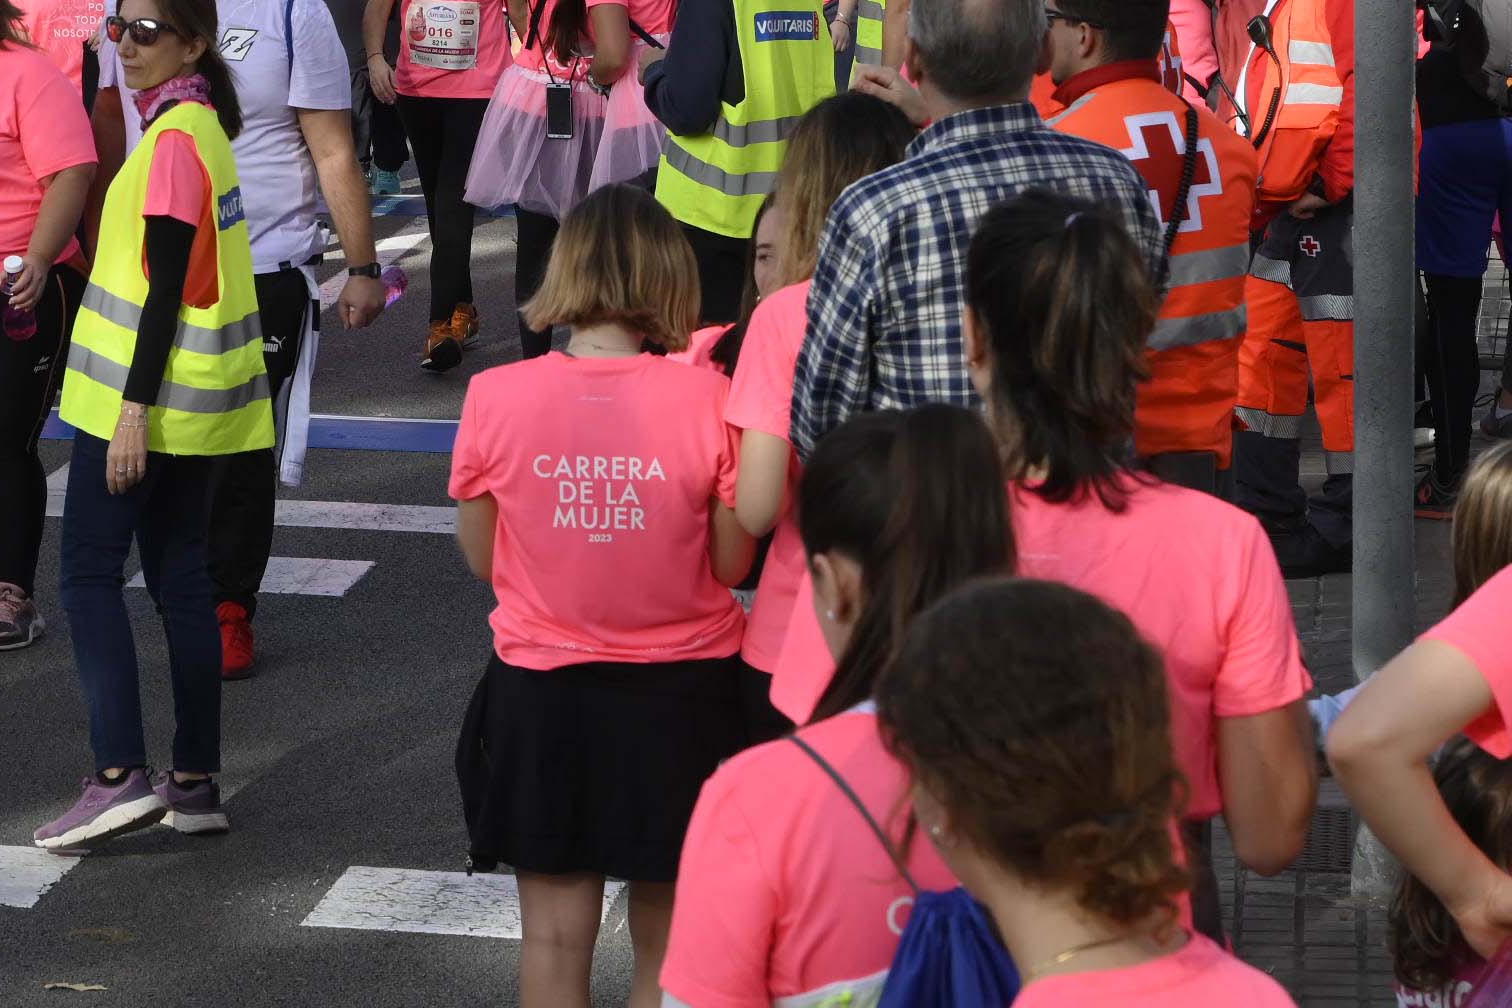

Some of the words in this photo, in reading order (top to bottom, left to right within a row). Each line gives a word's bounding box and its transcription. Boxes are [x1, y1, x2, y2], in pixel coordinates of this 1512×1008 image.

[428, 27, 453, 38] 016
[533, 455, 666, 481] CARRERA
[559, 481, 593, 504] DE
[606, 482, 640, 505] LA
[553, 506, 645, 530] MUJER
[588, 534, 612, 543] 2023
